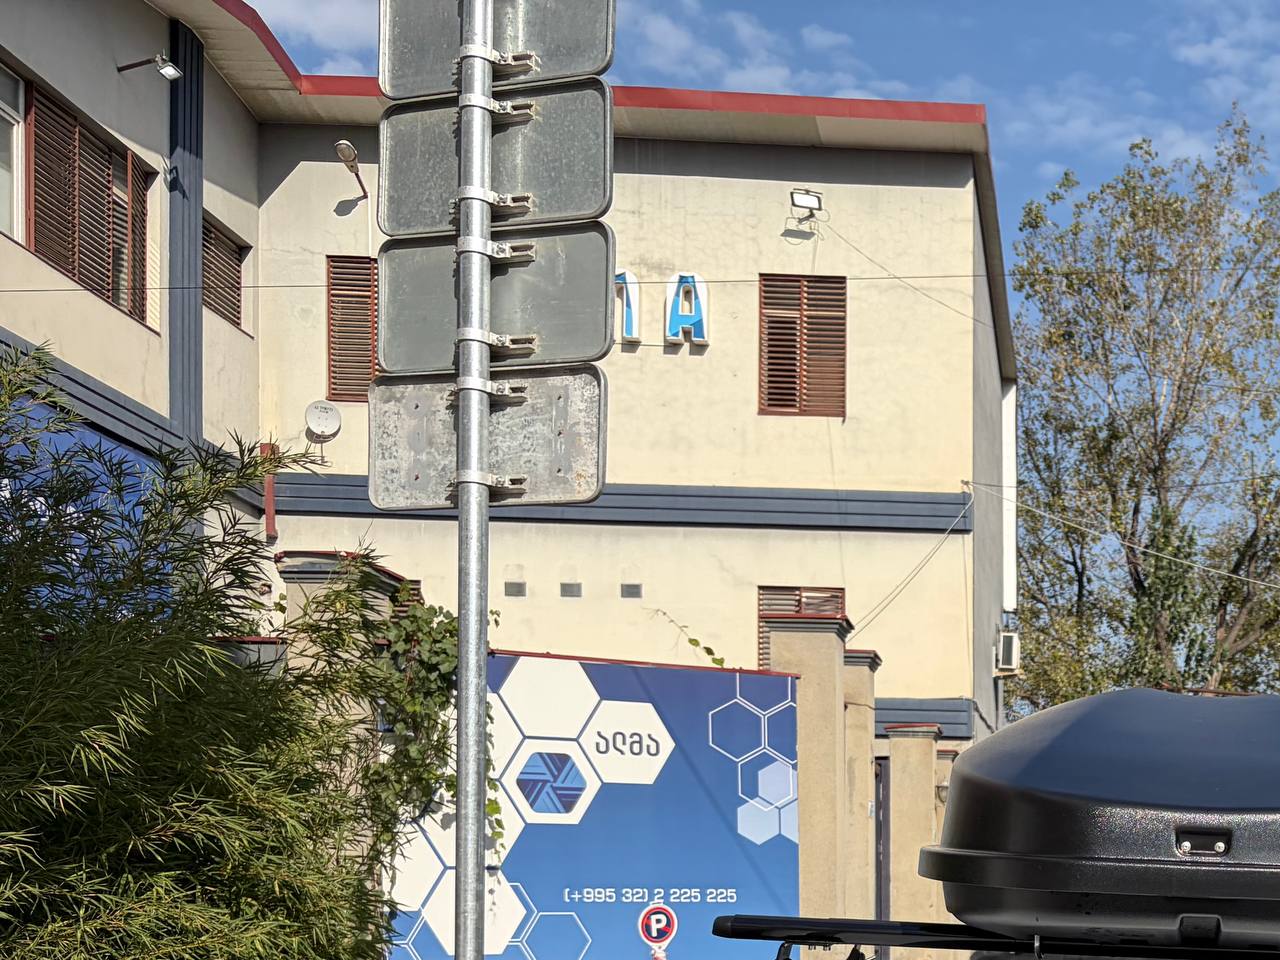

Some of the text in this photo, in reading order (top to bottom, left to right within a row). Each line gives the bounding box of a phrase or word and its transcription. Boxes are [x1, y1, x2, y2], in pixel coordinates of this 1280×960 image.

[595, 730, 660, 757] ალმა
[653, 888, 665, 902] 2
[670, 888, 701, 903] 225
[706, 888, 737, 903] 225
